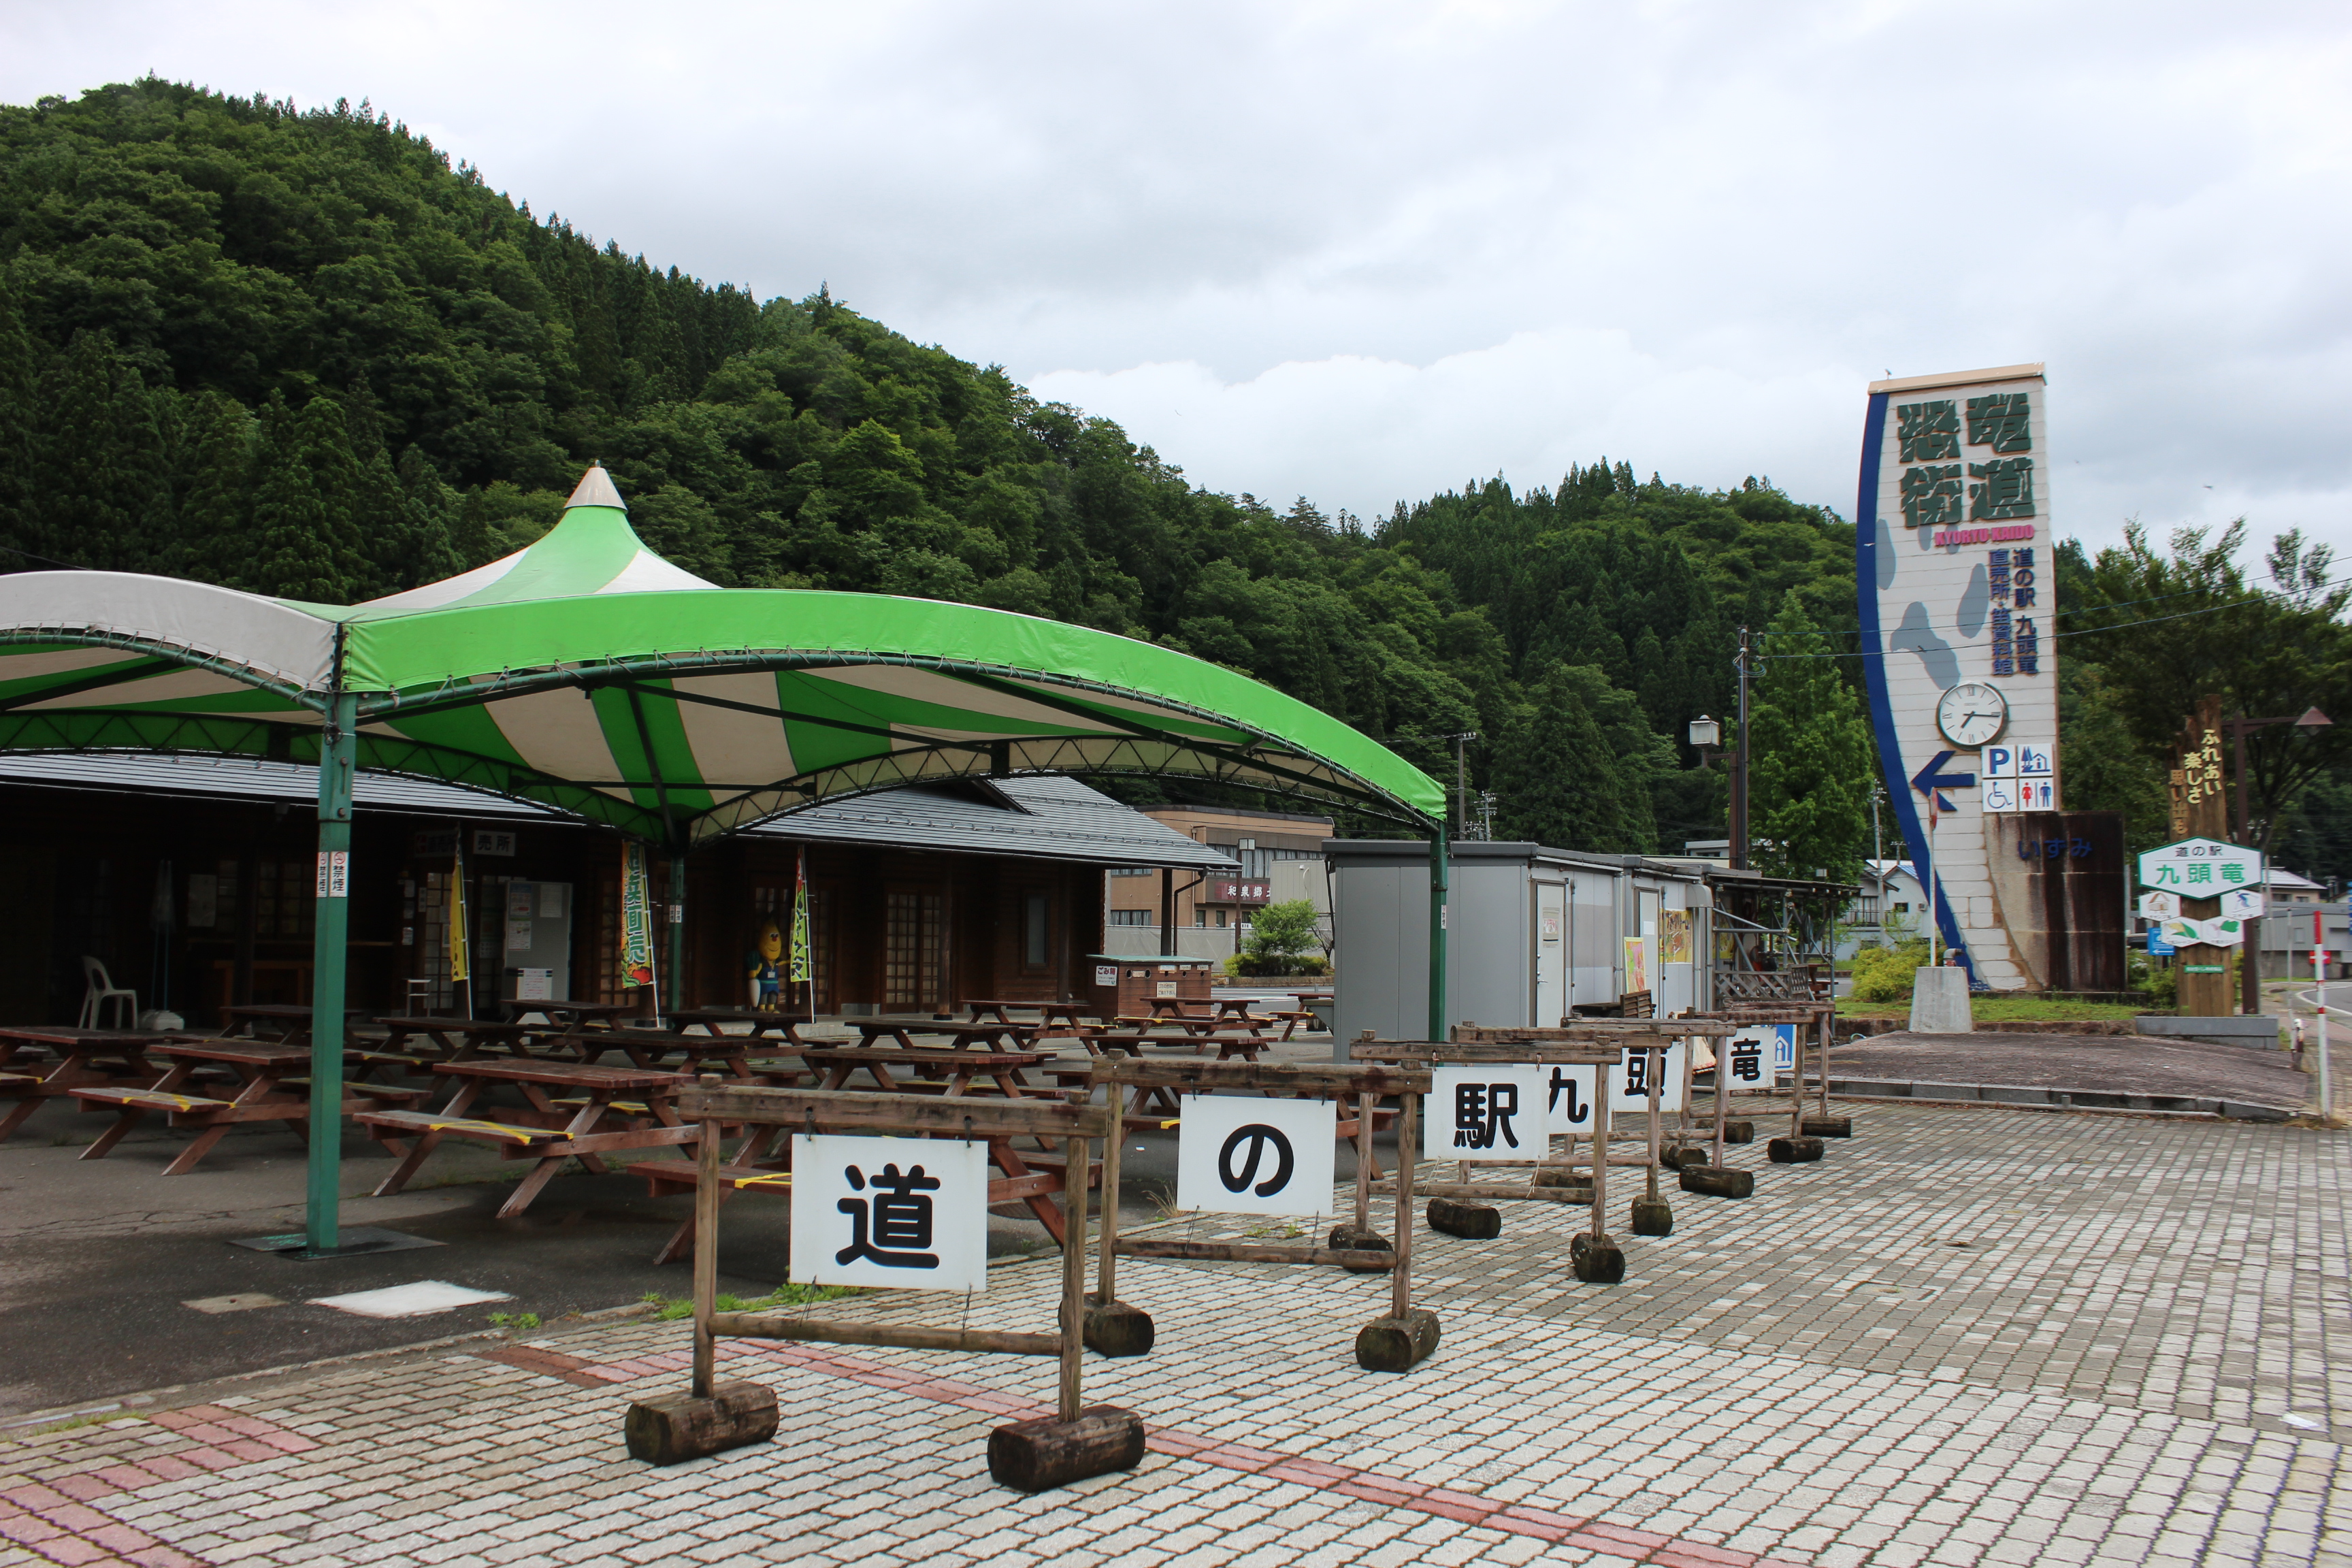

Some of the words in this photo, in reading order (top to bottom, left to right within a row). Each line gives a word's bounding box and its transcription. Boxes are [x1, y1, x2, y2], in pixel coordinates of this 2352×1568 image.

[1897, 393, 2031, 463] 恐竜
[1899, 457, 2035, 528] 街道
[1935, 528, 1989, 546] KYORYU
[1991, 524, 2035, 541] KAIDO
[2013, 547, 2036, 607] 道の駅
[2016, 615, 2038, 674] 九頭竜
[1989, 749, 2010, 774] P
[2184, 751, 2203, 804] 楽しさ
[2201, 729, 2223, 796] ふれあい
[2168, 769, 2189, 834] 思い出も
[2018, 838, 2093, 859] いずみ
[2156, 863, 2245, 885] 九頭竜
[2175, 845, 2223, 857] 道の駅
[332, 865, 344, 892] 禁煙
[1624, 1047, 1667, 1098] 頭
[1730, 1038, 1763, 1081] 竜
[1454, 1083, 1520, 1149] 駅
[1549, 1066, 1589, 1124] 九
[1218, 1123, 1295, 1198] の
[834, 1162, 941, 1269] 道
